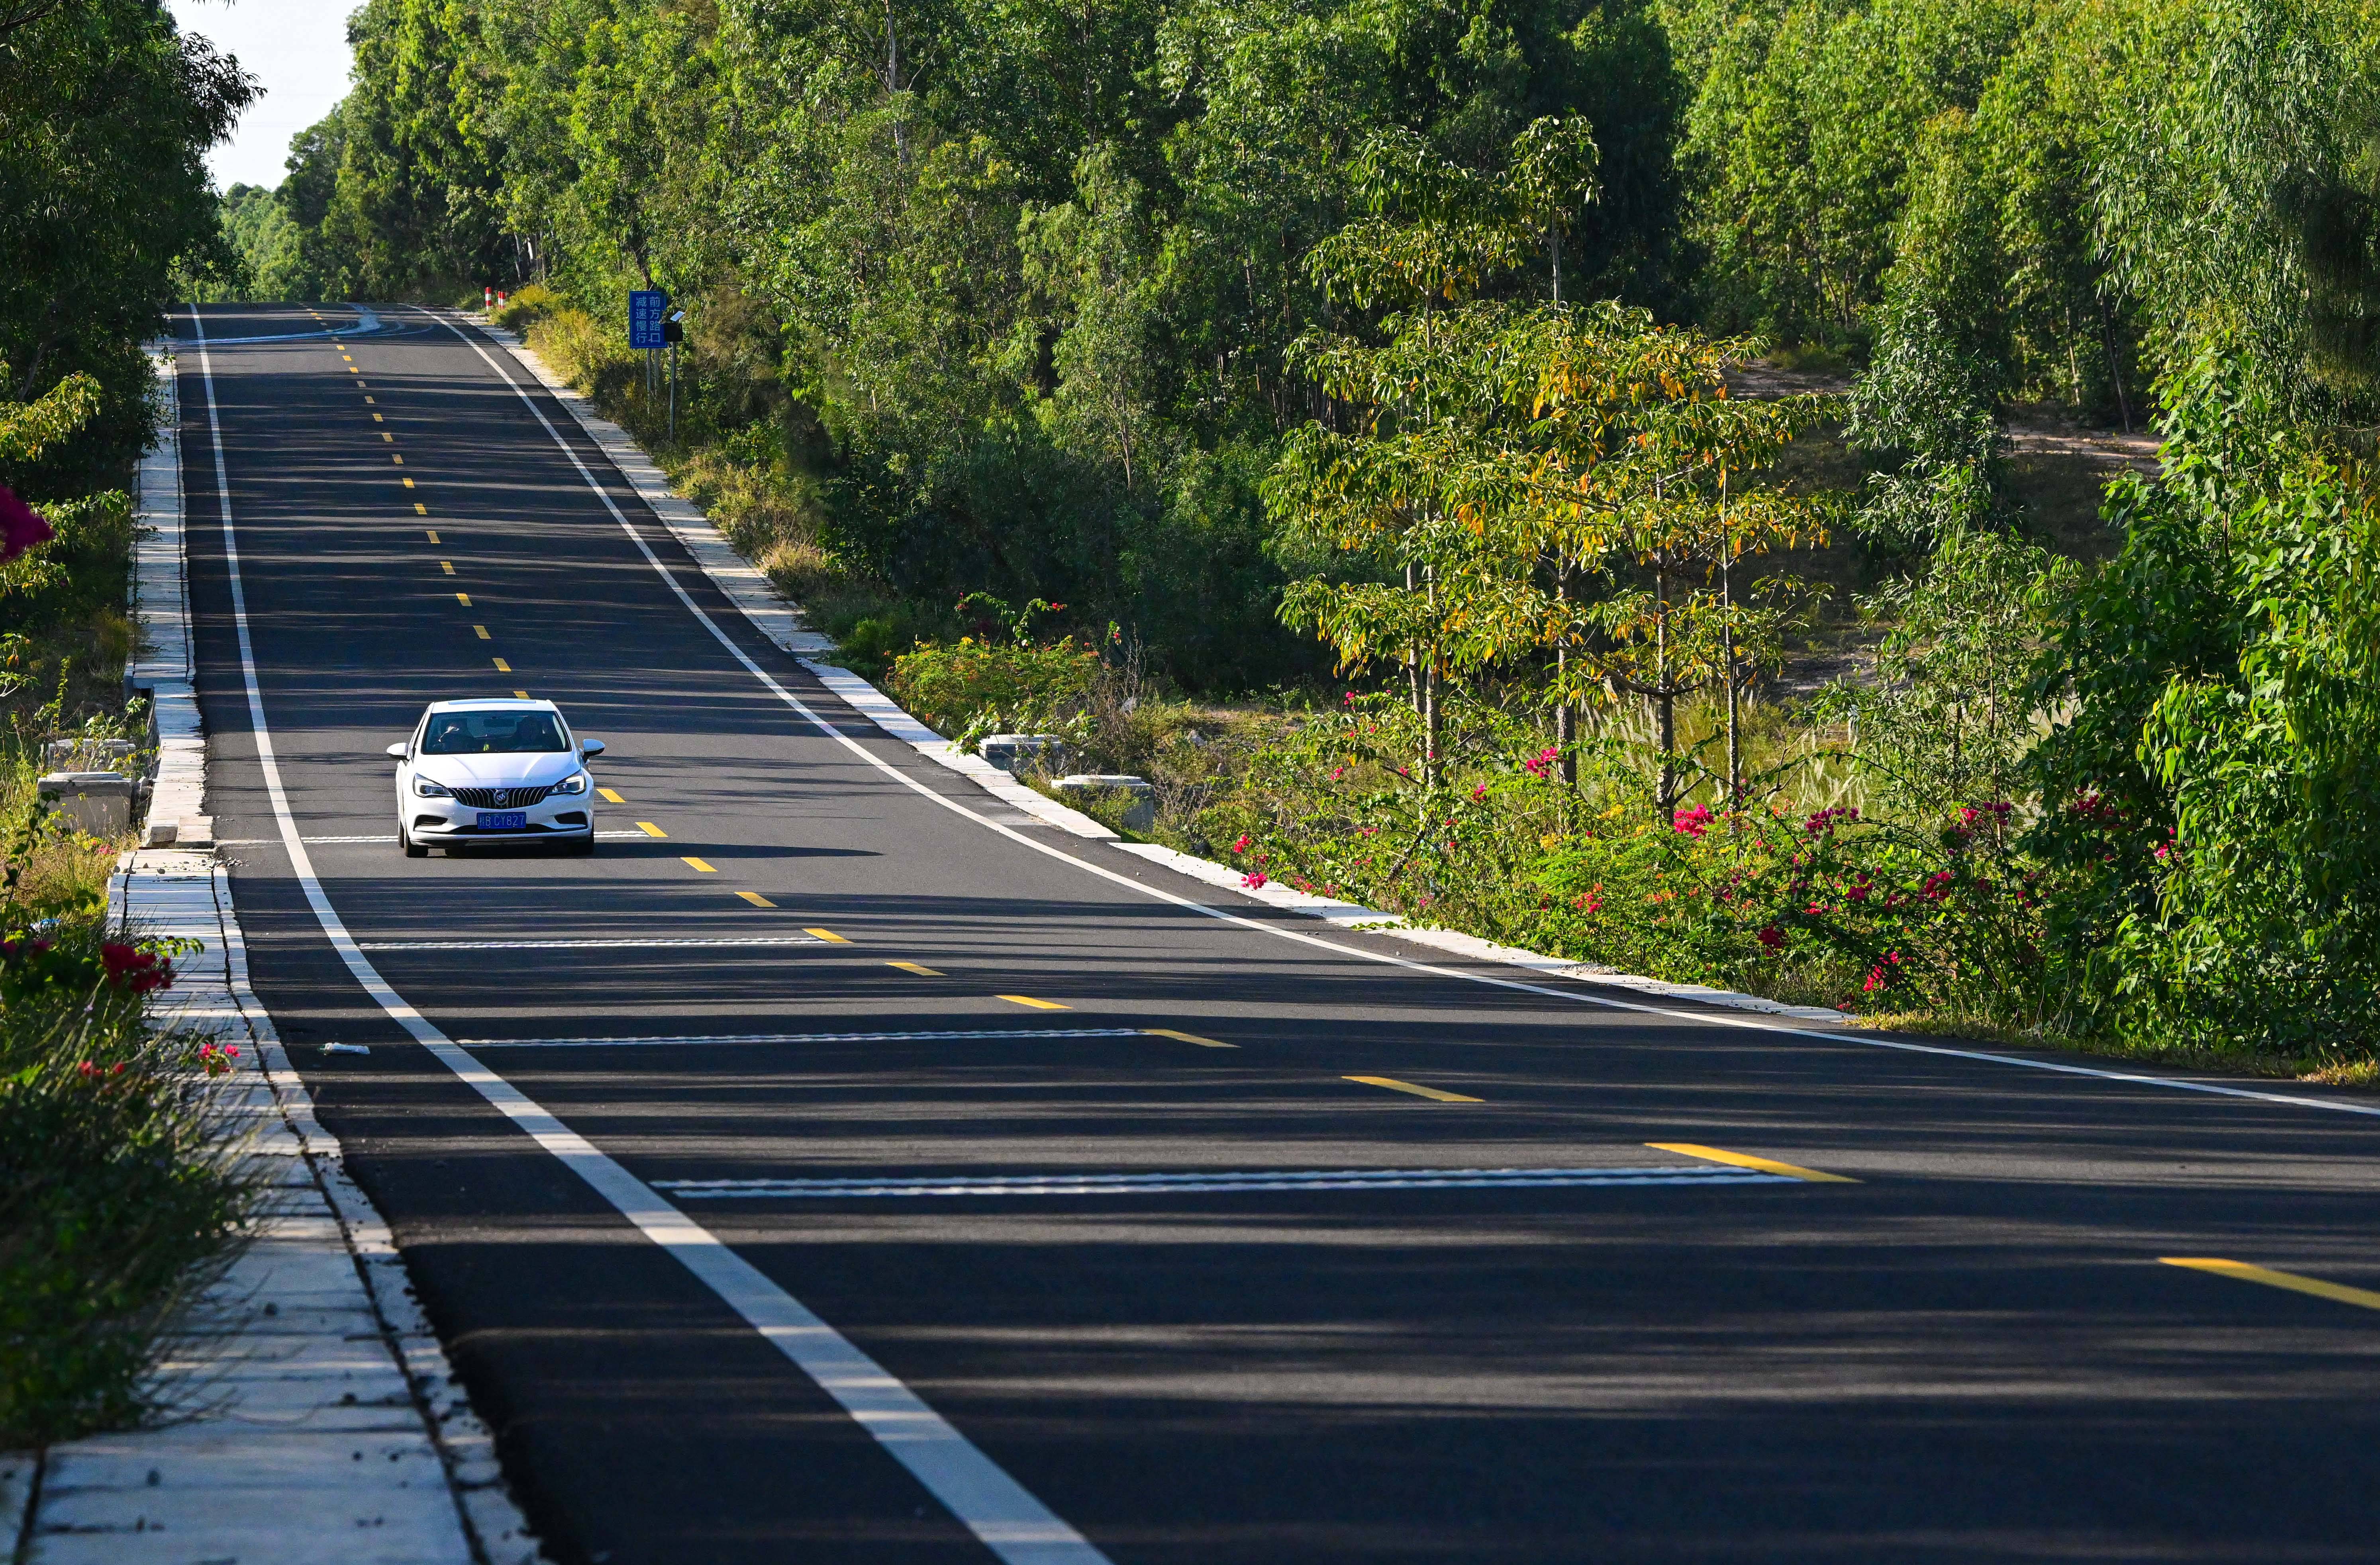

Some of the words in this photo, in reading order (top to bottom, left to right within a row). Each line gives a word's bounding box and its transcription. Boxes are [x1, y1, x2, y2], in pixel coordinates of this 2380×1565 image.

[636, 296, 647, 343] 减速慢行
[649, 296, 660, 343] 前方路口
